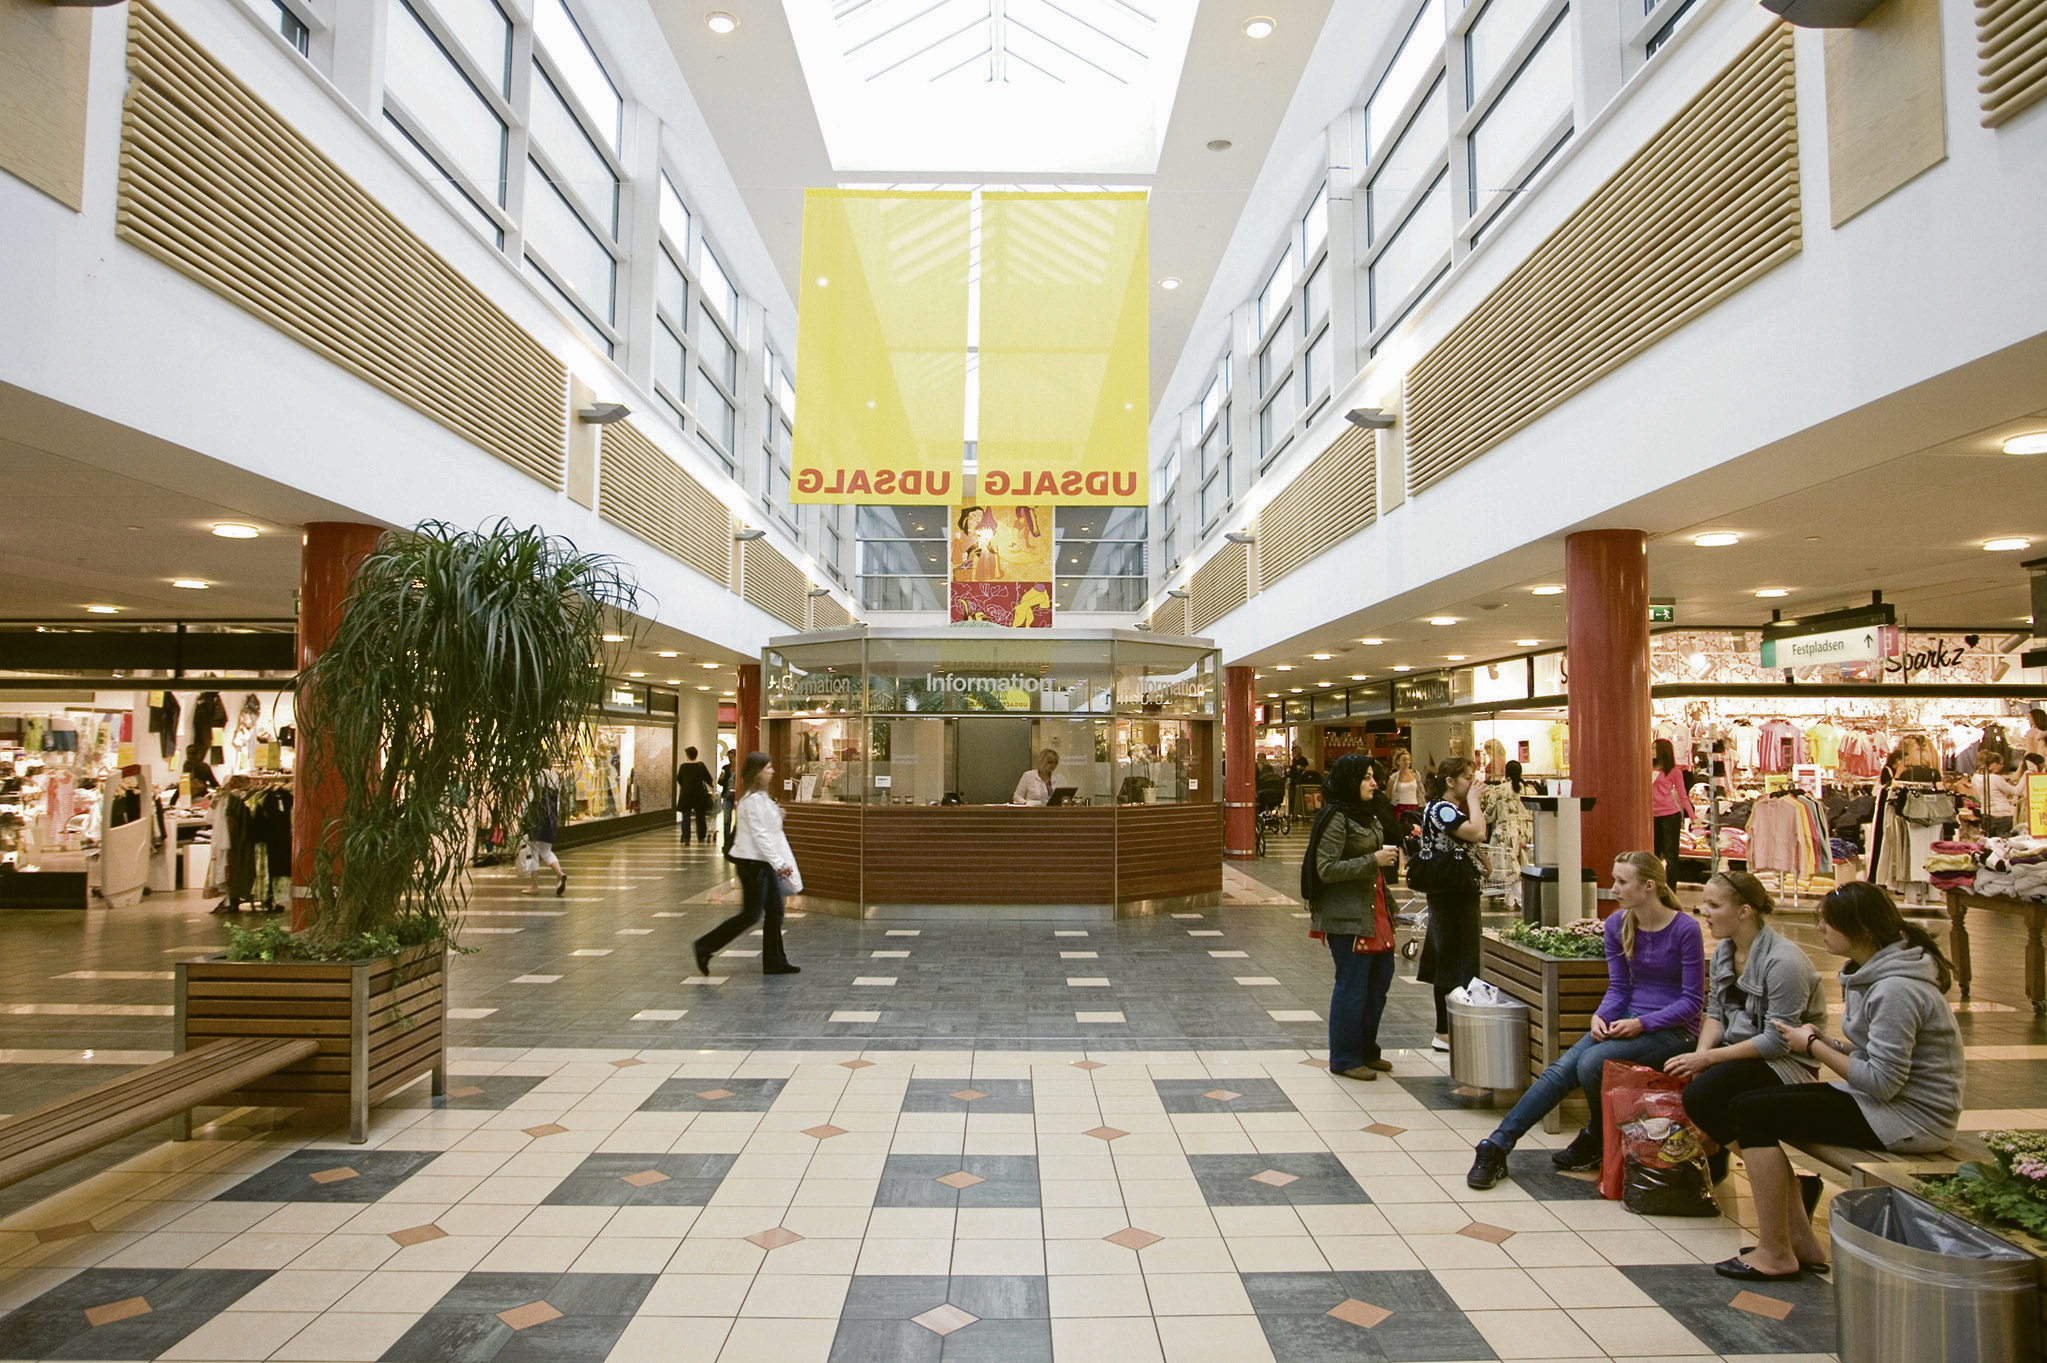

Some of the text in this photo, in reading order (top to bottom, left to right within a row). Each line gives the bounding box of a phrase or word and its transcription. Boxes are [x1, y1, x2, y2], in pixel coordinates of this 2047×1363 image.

[1792, 639, 1844, 656] Festpladsen
[777, 674, 850, 695] Information
[926, 672, 1054, 692] Information
